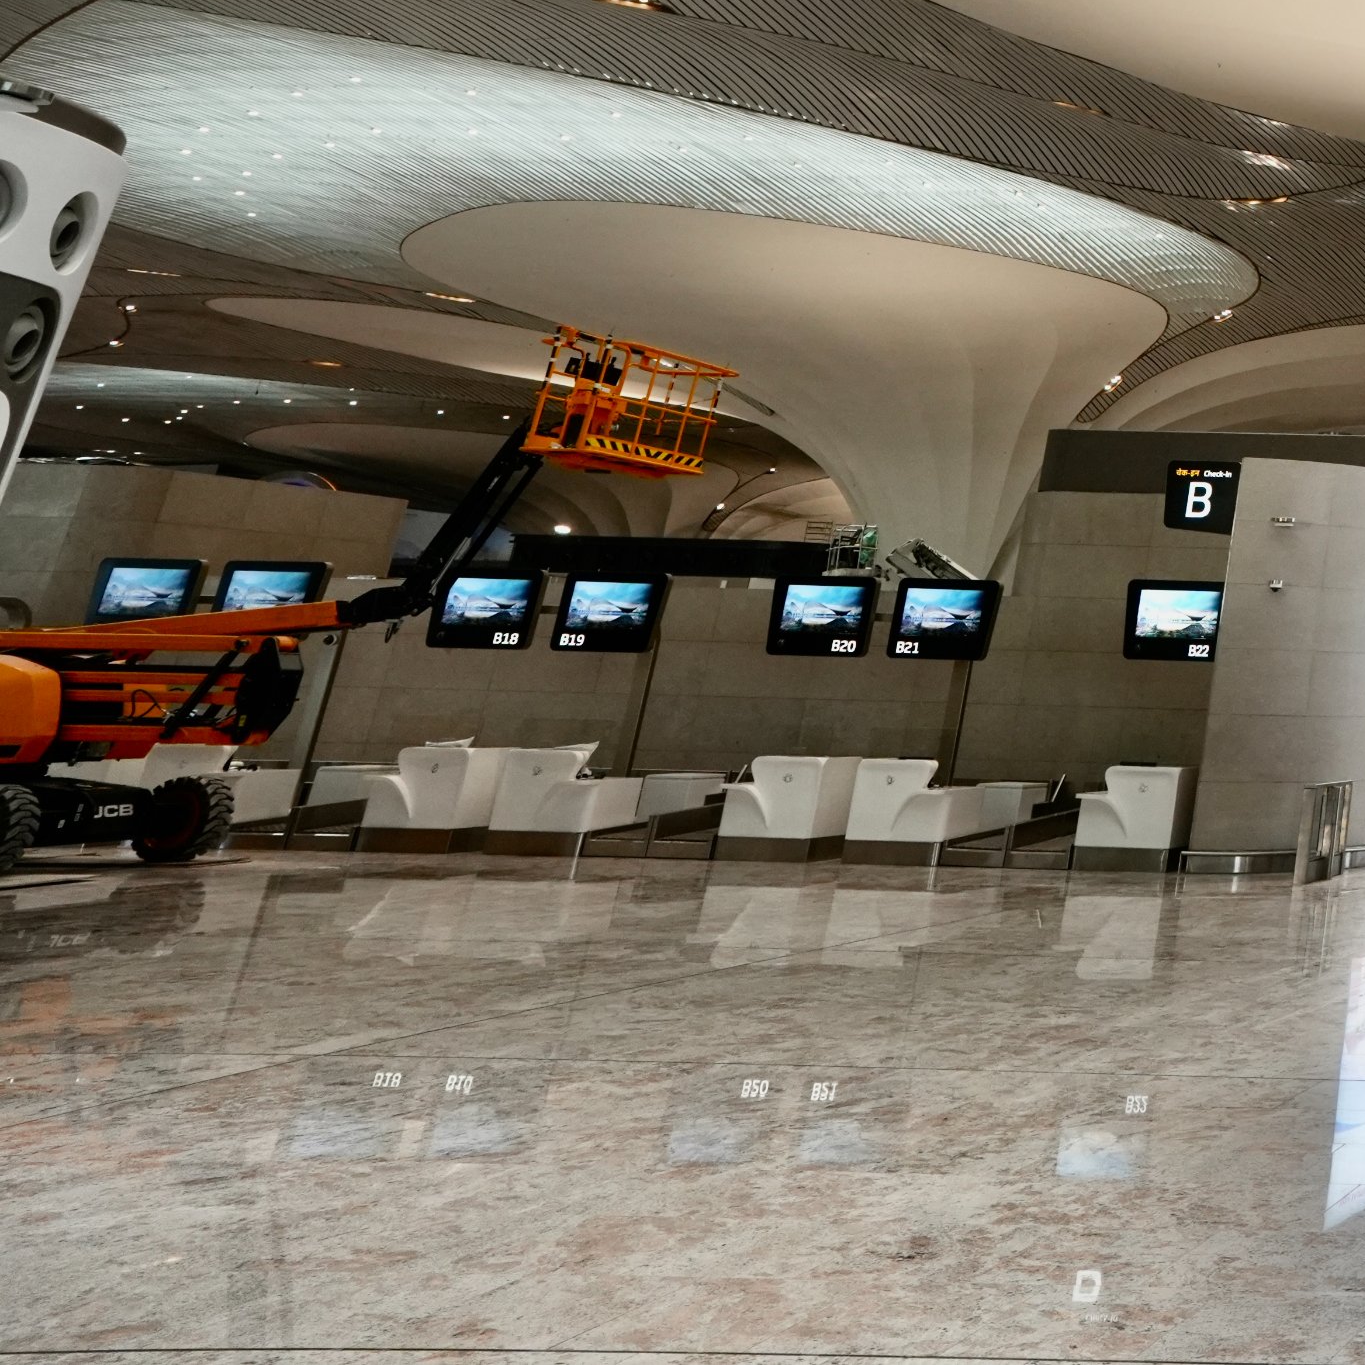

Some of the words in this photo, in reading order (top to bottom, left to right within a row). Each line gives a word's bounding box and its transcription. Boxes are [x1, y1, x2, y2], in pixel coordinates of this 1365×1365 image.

[1185, 482, 1212, 518] B
[492, 632, 519, 644] B18
[560, 634, 585, 646] B19
[831, 640, 856, 652] B20
[896, 641, 920, 654] B21
[1188, 644, 1210, 658] B22
[94, 804, 134, 818] JCB
